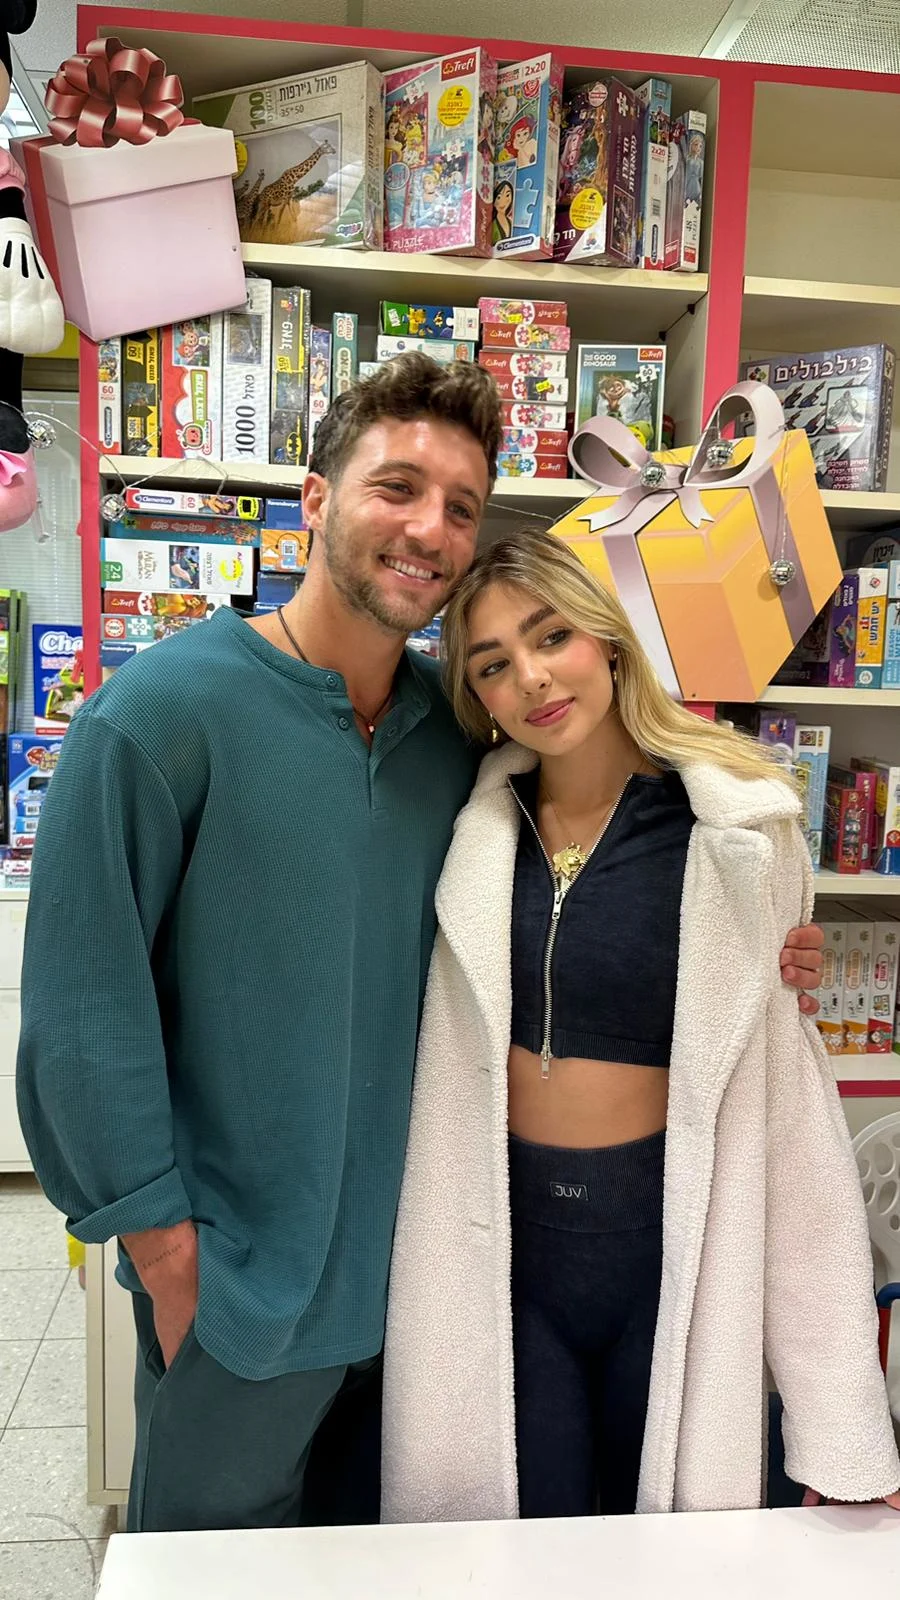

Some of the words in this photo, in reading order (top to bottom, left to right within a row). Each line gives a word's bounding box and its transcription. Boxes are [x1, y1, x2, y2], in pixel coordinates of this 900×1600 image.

[453, 57, 475, 72] Trefl
[525, 61, 546, 76] 2x20
[314, 75, 338, 92] פאזל
[249, 91, 266, 130] 100
[651, 146, 665, 156] 2x20
[279, 321, 293, 350] פאזל
[498, 330, 512, 339] Trefl
[127, 344, 136, 358] 60
[648, 350, 662, 359] Trefl
[339, 349, 349, 377] פאזל
[493, 359, 507, 368] Trefl
[583, 360, 617, 368] DINOSAUR
[776, 355, 873, 382] בילבולים
[642, 368, 653, 377] 60
[102, 386, 114, 395] 60
[242, 374, 255, 400] פאזל
[313, 400, 325, 409] 60
[236, 405, 256, 456] 1000
[547, 438, 562, 447] Trefl
[546, 463, 561, 472] Trefl
[142, 496, 173, 505] Clementoni
[187, 497, 196, 509] 60
[267, 500, 300, 509] Ravensburger
[110, 564, 122, 580] 24
[119, 599, 135, 608] Trefl
[871, 601, 880, 615] יש
[869, 617, 879, 641] חמש
[42, 632, 83, 654] Cha
[555, 1185, 581, 1198] JUV
